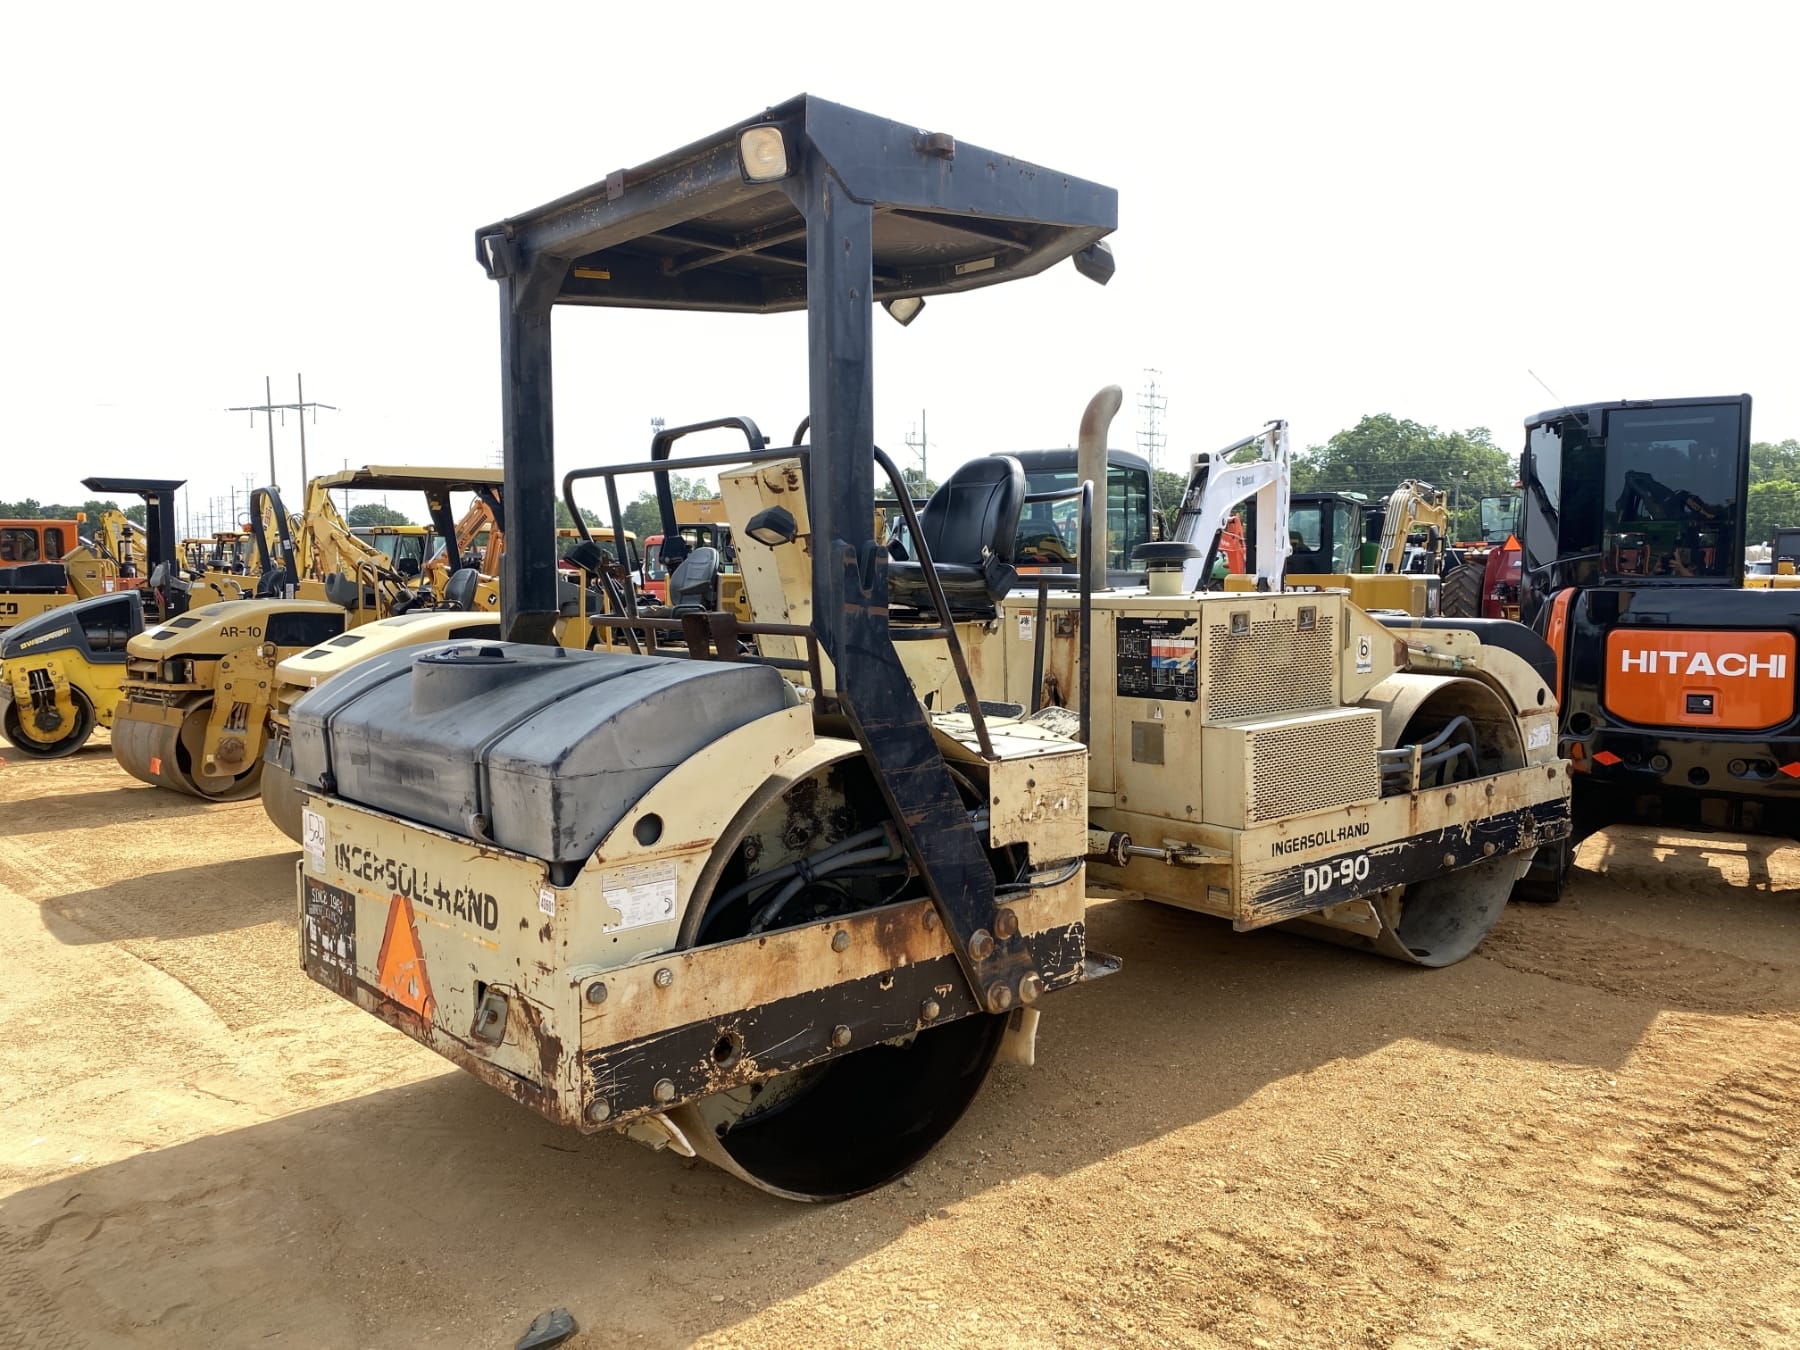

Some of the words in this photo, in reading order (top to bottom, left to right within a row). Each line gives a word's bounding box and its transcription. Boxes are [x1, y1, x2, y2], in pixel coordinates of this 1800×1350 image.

[220, 626, 262, 638] AR-10
[1621, 649, 1787, 679] HITACHI
[1271, 822, 1370, 857] INGERSOLL-RAND
[1304, 854, 1370, 896] DD-90
